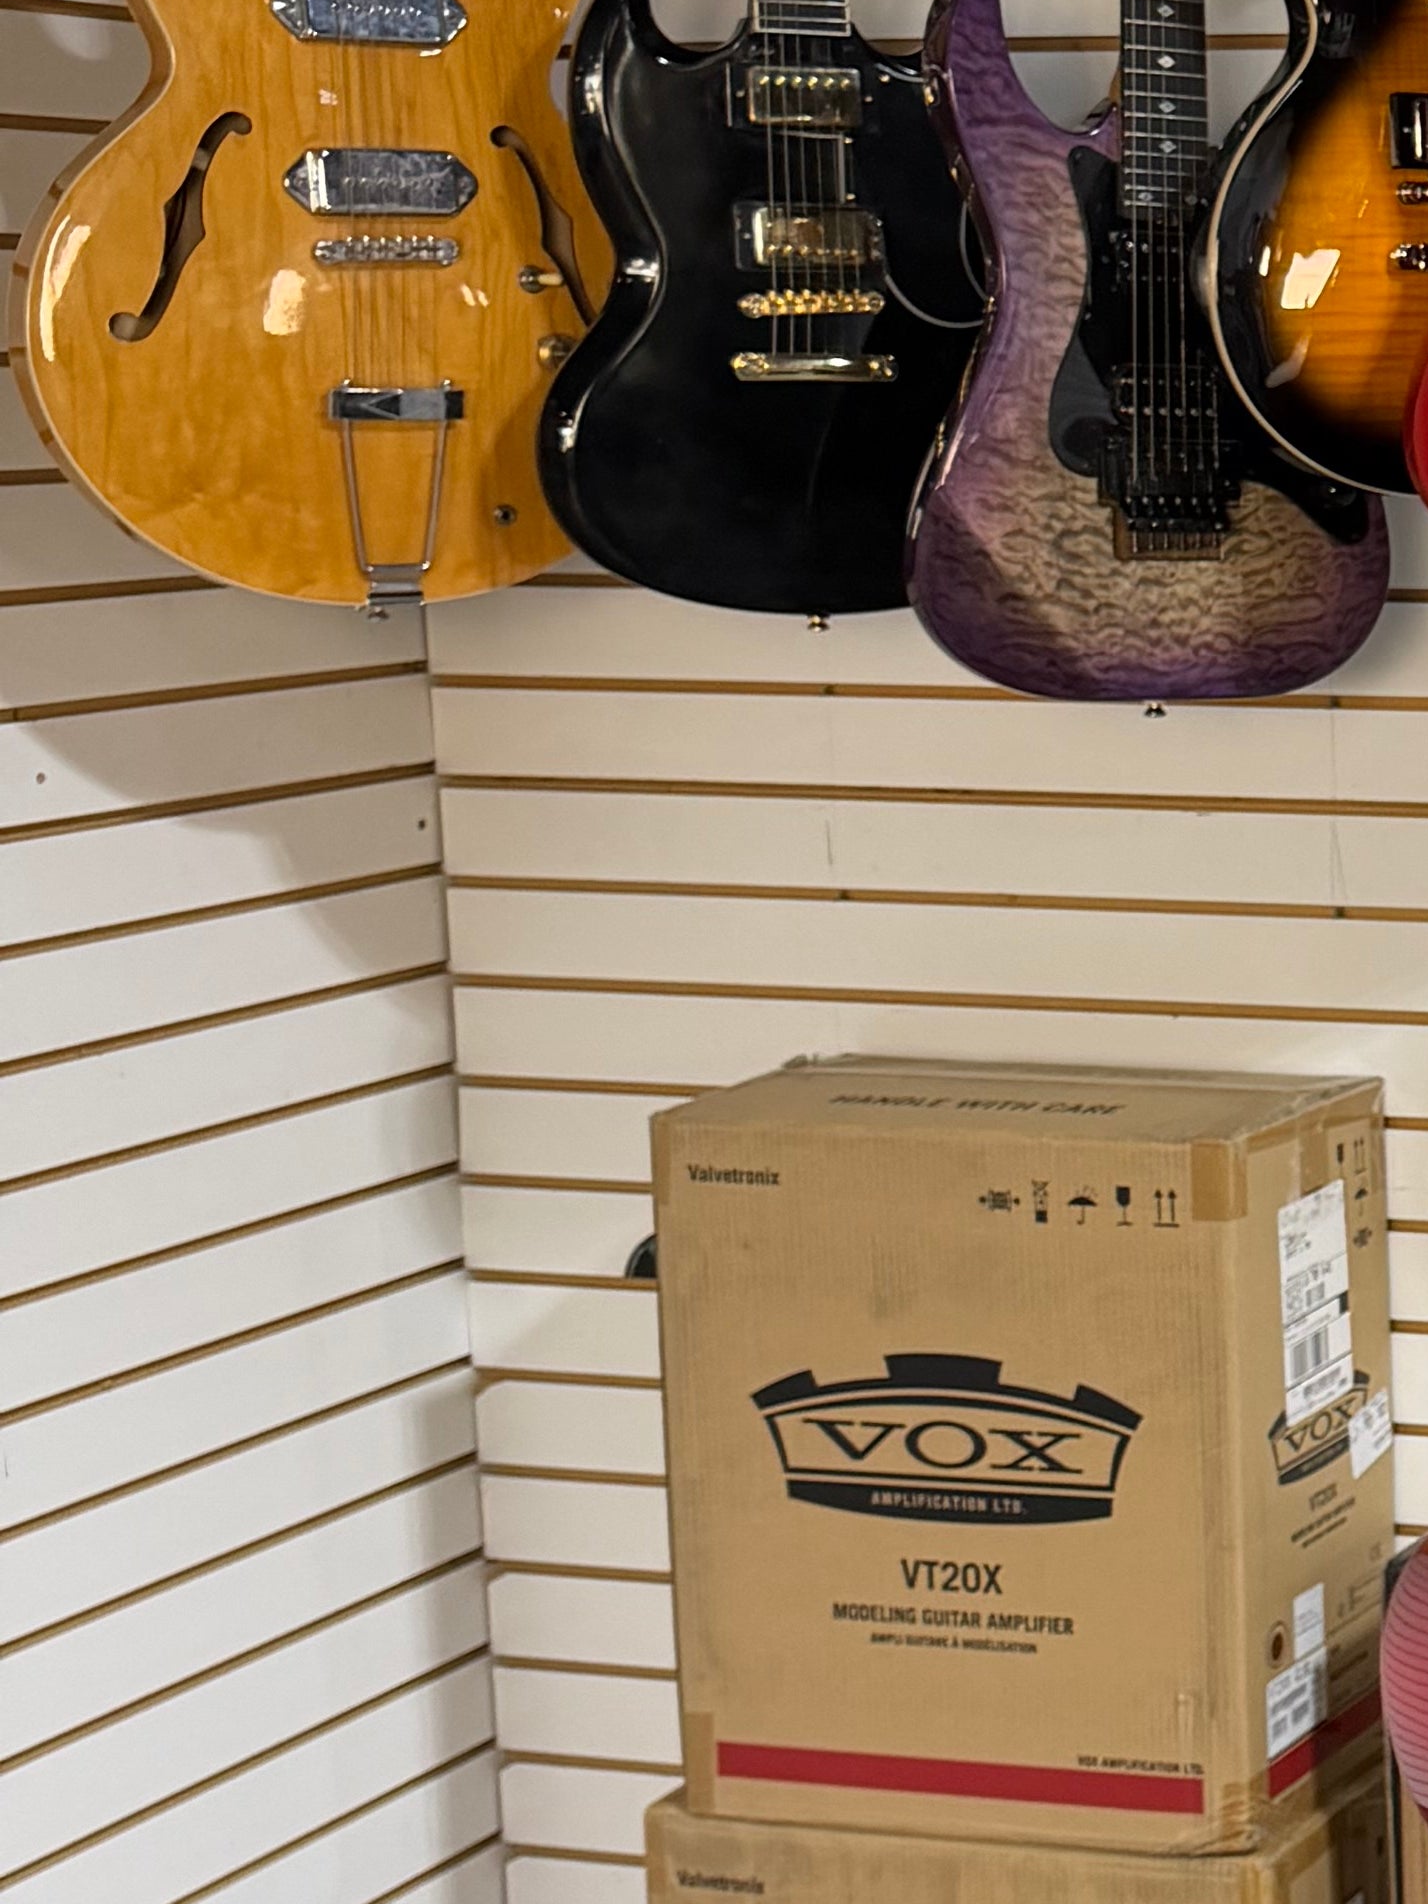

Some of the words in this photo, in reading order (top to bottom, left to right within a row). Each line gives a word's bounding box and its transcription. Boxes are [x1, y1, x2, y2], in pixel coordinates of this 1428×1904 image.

[956, 1099, 1039, 1114] WITH
[1043, 1102, 1129, 1116] CARE
[687, 1163, 782, 1187] Valvetronix
[802, 1417, 1084, 1474] VOX
[870, 1491, 987, 1513] AMPLIFICATION
[991, 1498, 1029, 1515] LTD.
[900, 1558, 1004, 1595] VT20X
[832, 1602, 917, 1625] MODELING
[922, 1608, 981, 1629] GUITAR
[986, 1612, 1075, 1635] AMPLIFIER
